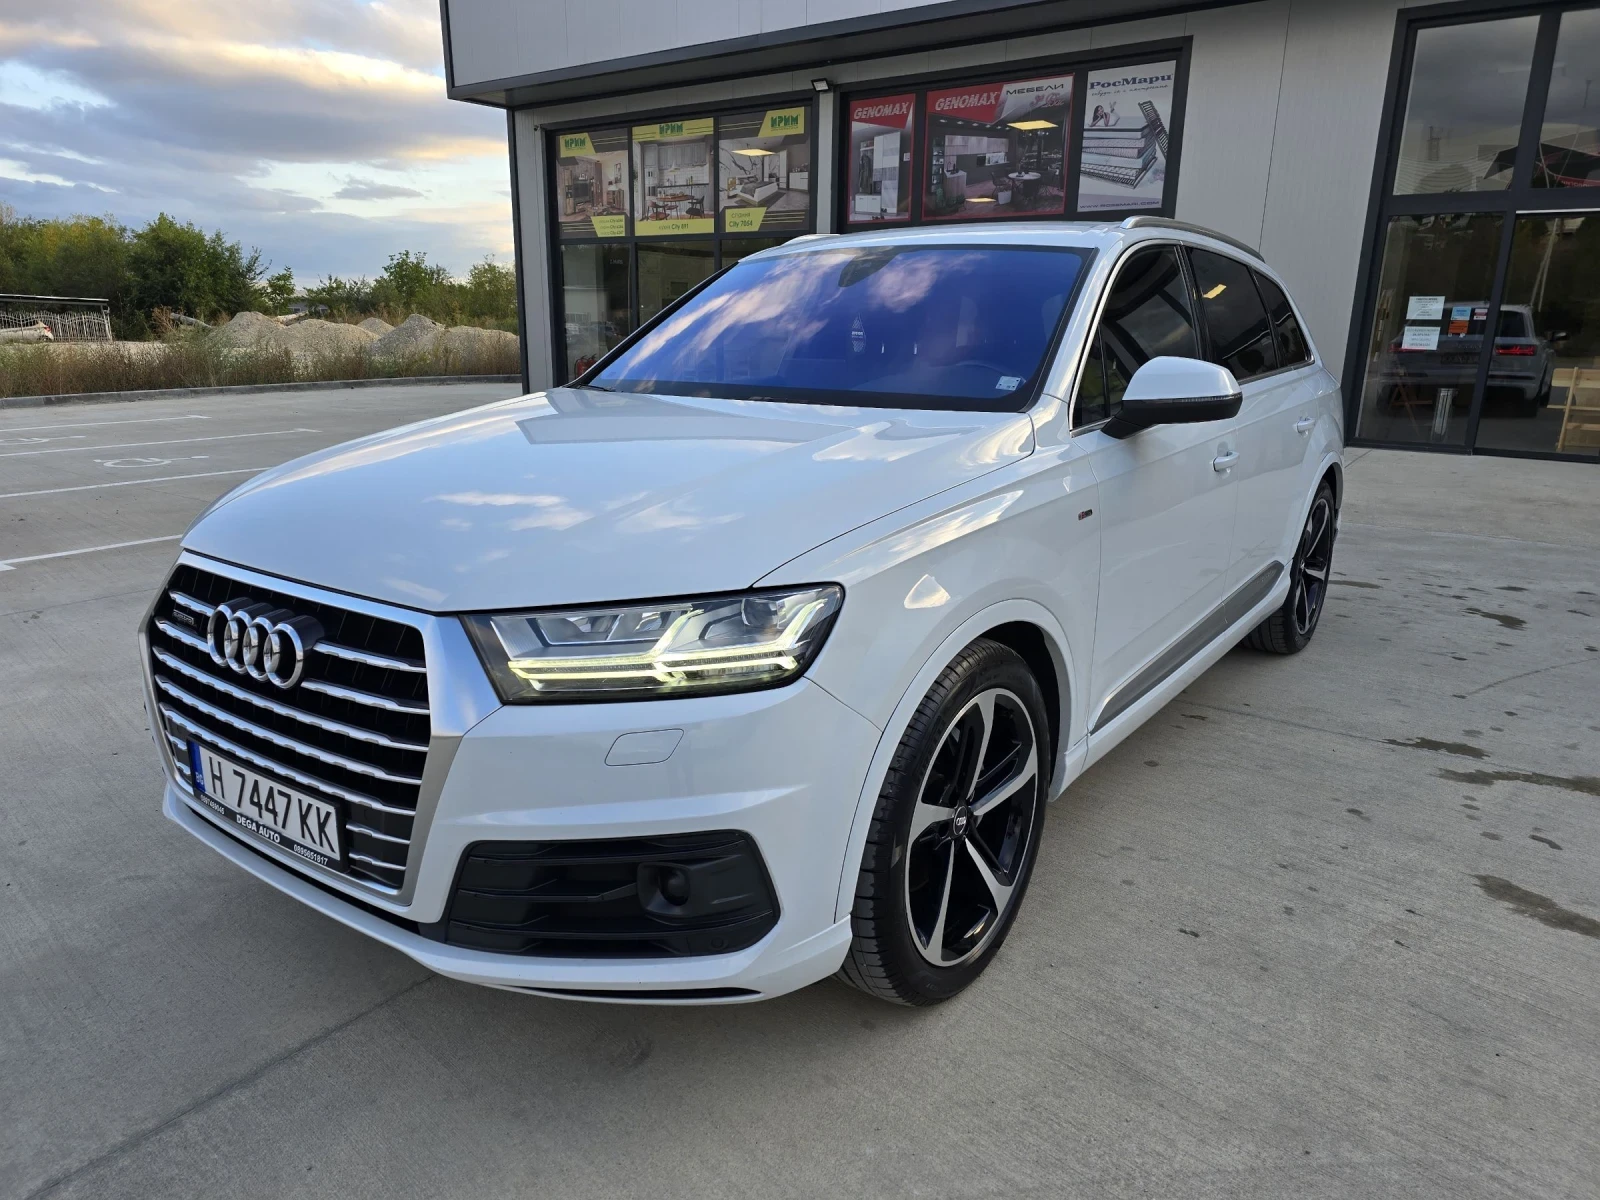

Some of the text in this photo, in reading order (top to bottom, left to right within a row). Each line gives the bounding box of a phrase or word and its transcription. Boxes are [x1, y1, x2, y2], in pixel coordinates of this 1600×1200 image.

[1006, 83, 1064, 96] МЕБЕЛИ
[1089, 74, 1172, 89] РосМари
[853, 101, 909, 120] GENOMAX
[935, 91, 997, 111] GENOMAX
[195, 771, 204, 786] BG
[209, 756, 336, 854] H 7447 KK
[236, 814, 281, 843] DEGA AUTO
